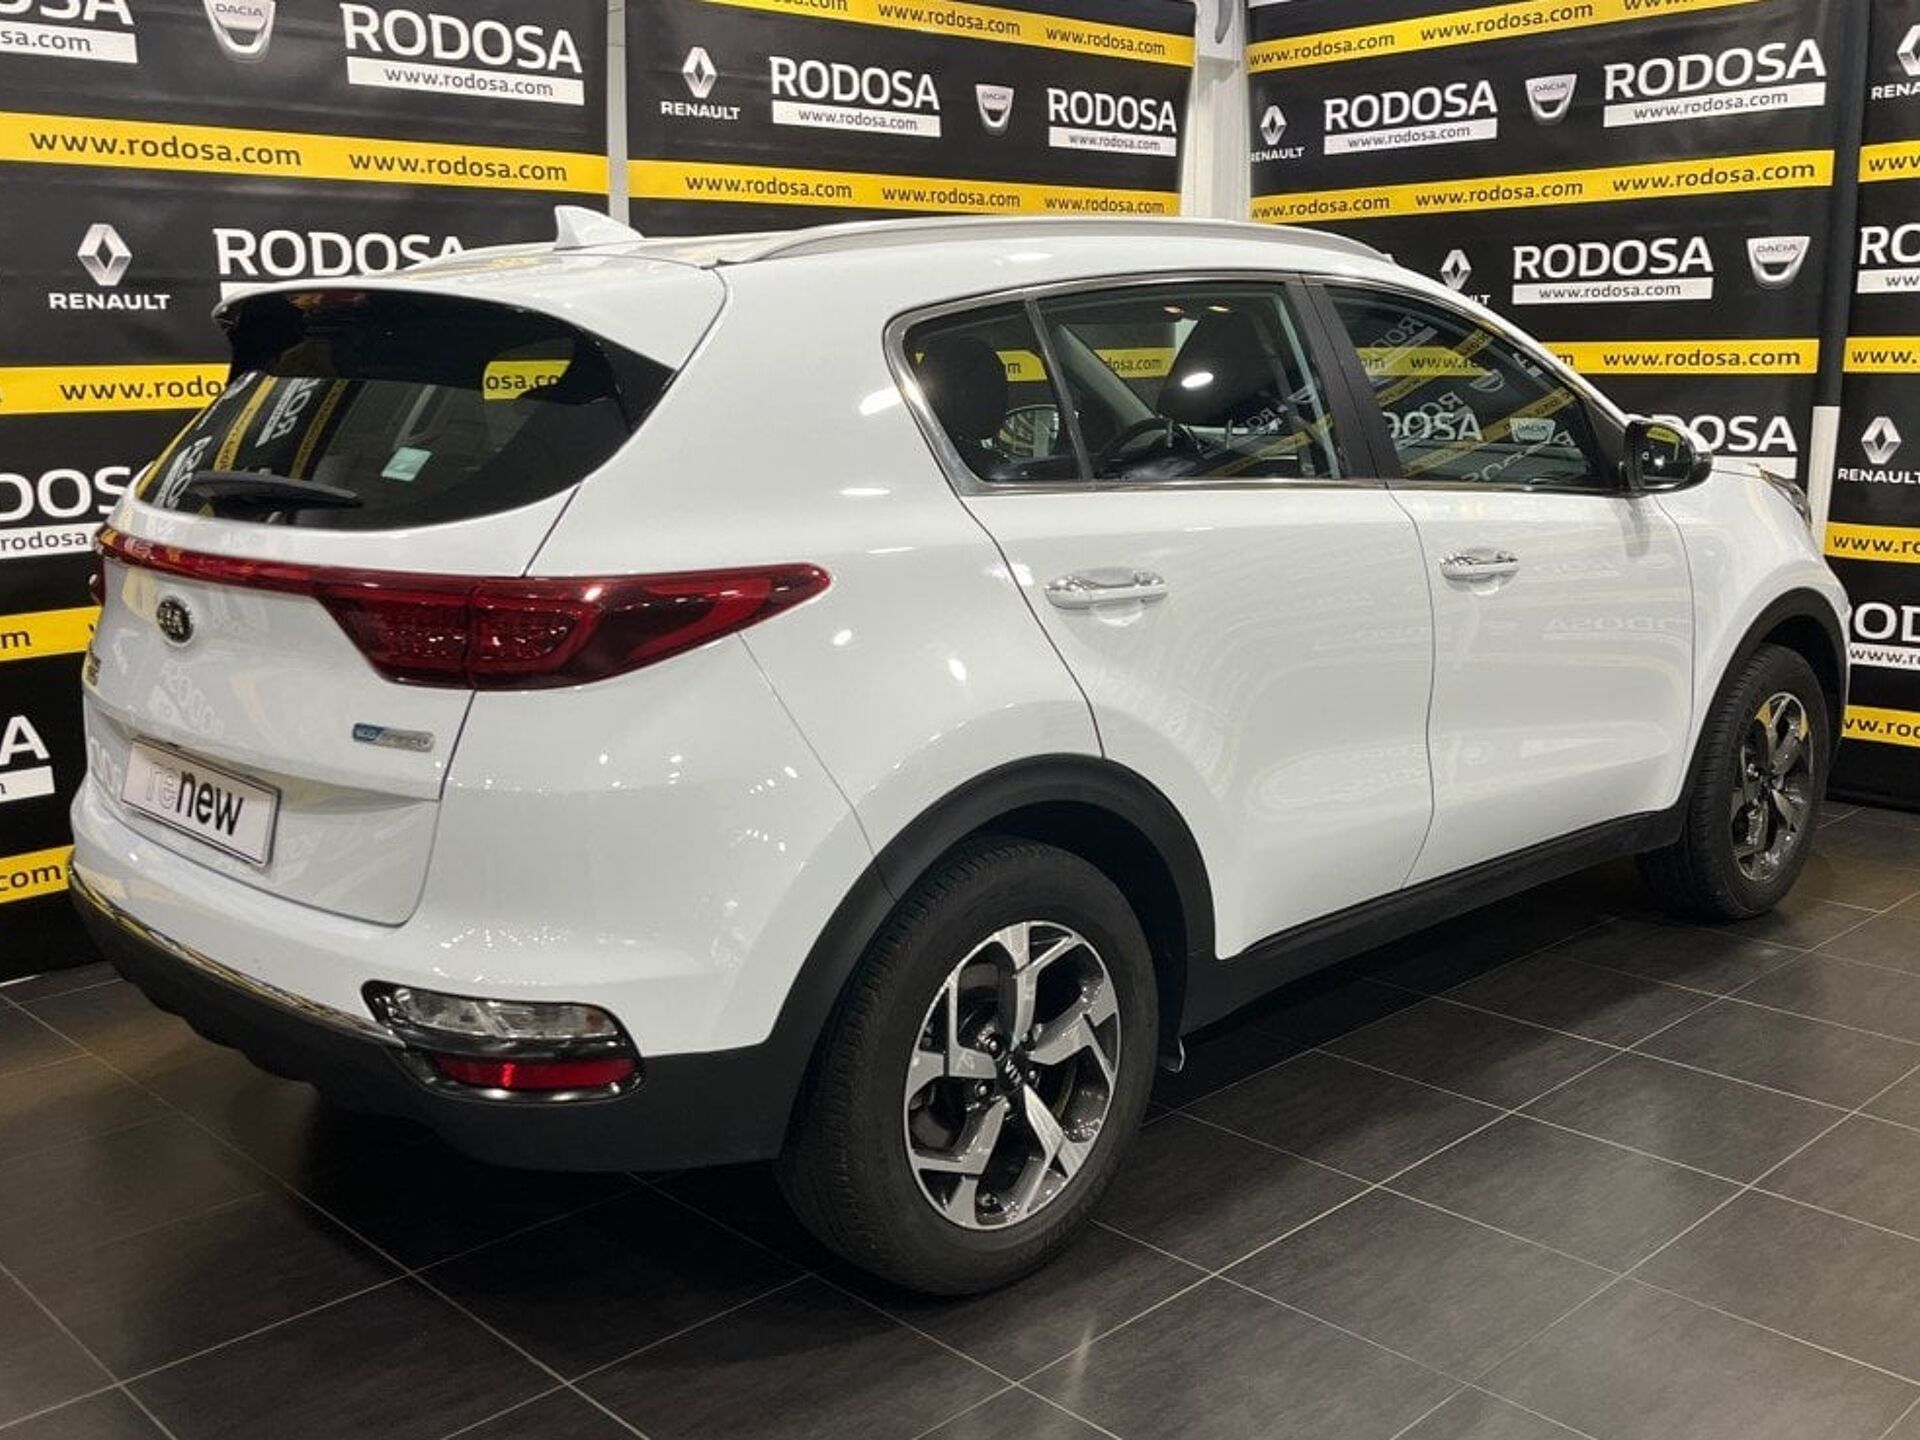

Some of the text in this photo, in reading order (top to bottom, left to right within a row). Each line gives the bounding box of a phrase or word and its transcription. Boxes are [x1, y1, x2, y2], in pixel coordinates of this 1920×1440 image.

[215, 3, 264, 18] DACIA
[878, 4, 1021, 36] www.rodosa.com
[1046, 26, 1165, 56] www.rodosa.com
[340, 3, 583, 73] RODOSA
[1250, 33, 1395, 66] www.rodosa.com
[1420, 4, 1594, 42] www.rodosa.com
[384, 68, 554, 97] www.rodosa.com
[769, 56, 940, 110] RODOSA
[1604, 38, 1828, 100] RODOSA
[660, 101, 741, 120] RENAULT
[798, 108, 918, 131] www.rodosa.com
[1047, 88, 1177, 132] RODOSA
[1323, 80, 1498, 132] RODOSA
[1634, 91, 1788, 120] www.rodosa.com
[30, 132, 568, 181] www.rodosa.com www.rodosa.com
[1069, 134, 1161, 151] www.rodosa.com
[1348, 125, 1471, 149] www.rodosa.com
[685, 175, 1165, 214] www.rodosa.com www.rodosa.com www.rodosa.com
[1416, 181, 1583, 206] www.rodosa.com
[1612, 163, 1816, 192] www.rodosa.com
[1513, 236, 1714, 280] RODOSA
[49, 293, 171, 310] RENAULT
[1539, 284, 1681, 300] www.rodosa.com
[1603, 349, 1800, 367] www.rodosa.com
